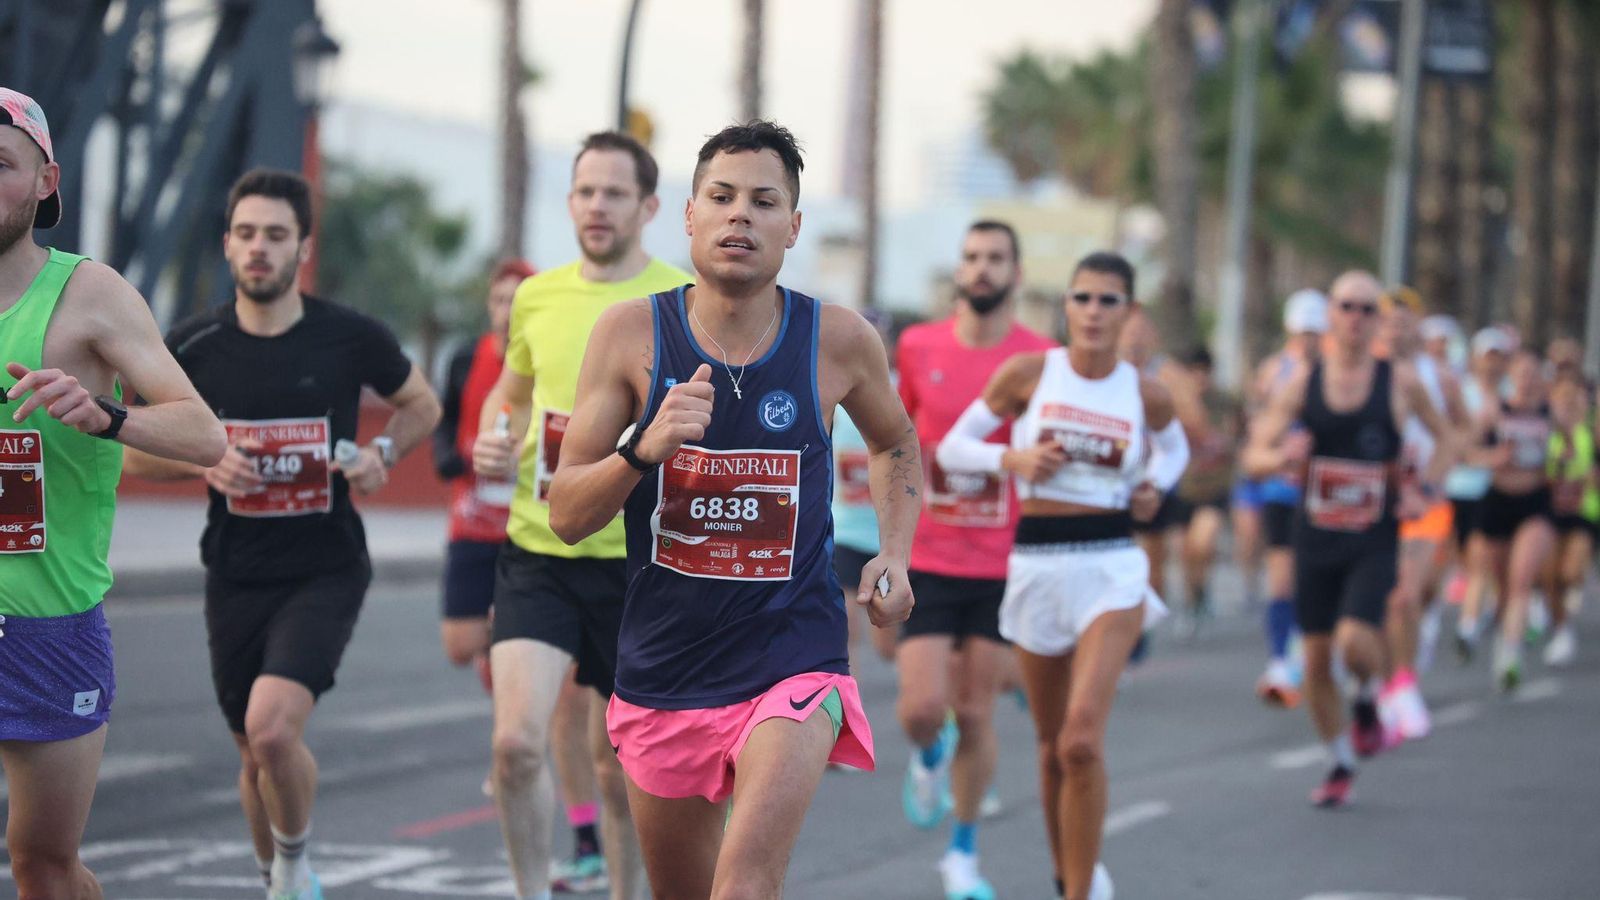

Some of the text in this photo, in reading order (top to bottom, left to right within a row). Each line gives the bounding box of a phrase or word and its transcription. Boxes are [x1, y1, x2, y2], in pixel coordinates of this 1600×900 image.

[697, 457, 789, 477] GENERALI
[690, 497, 759, 521] 6838
[0, 524, 24, 533] 42K
[704, 522, 743, 532] MONIER
[748, 550, 773, 558] 42K
